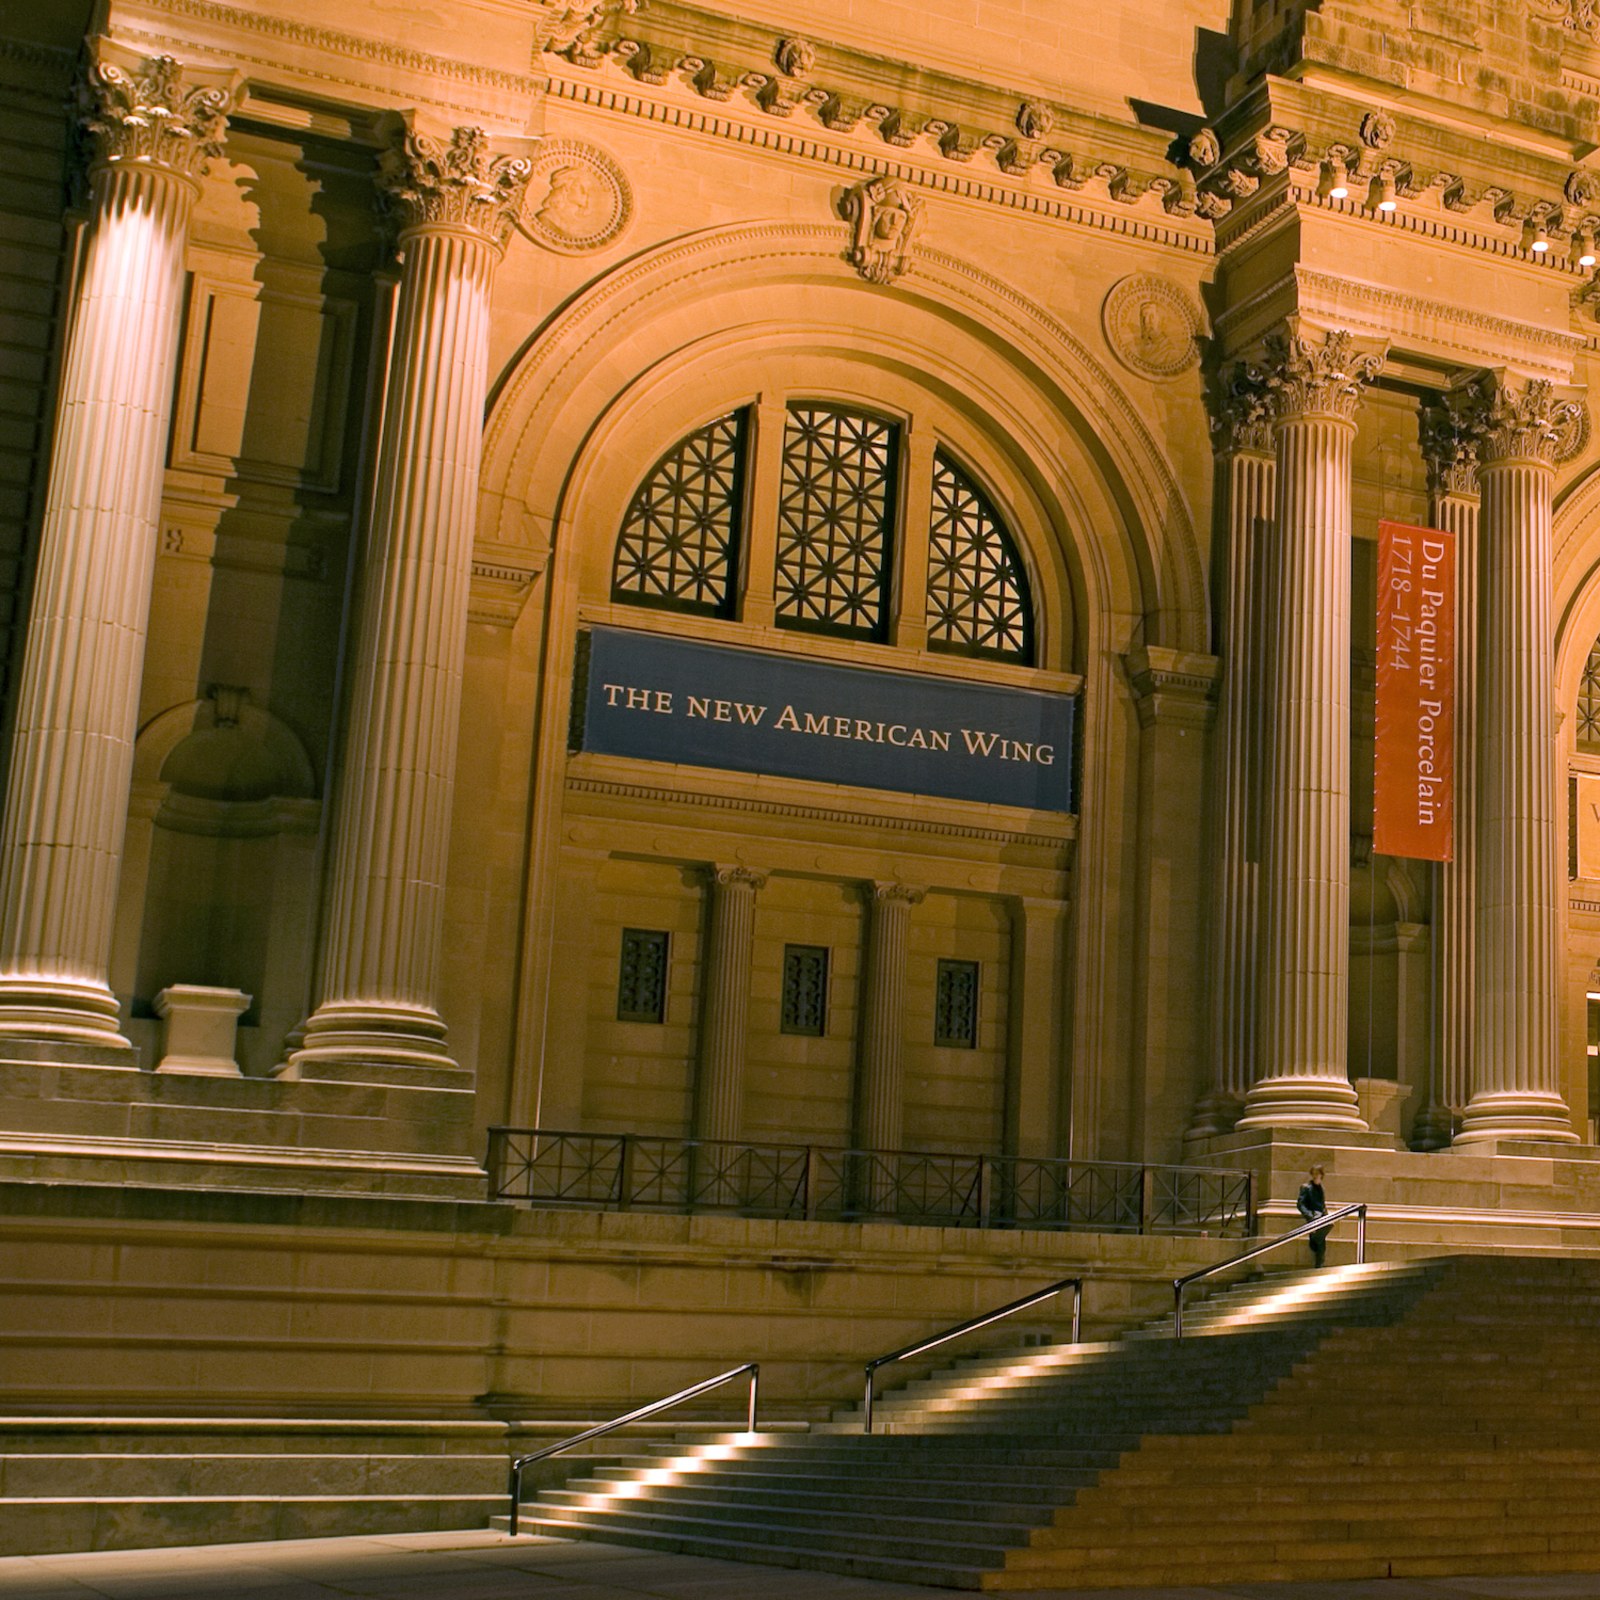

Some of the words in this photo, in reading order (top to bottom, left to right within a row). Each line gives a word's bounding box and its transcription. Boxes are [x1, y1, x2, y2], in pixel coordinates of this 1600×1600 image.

[1421, 538, 1445, 580] Du
[1414, 589, 1445, 691] Paquier
[603, 683, 674, 715] THE
[687, 695, 768, 726] NEW
[774, 704, 951, 752] AMERICAN
[960, 729, 1056, 766] WING
[1418, 699, 1444, 826] Porcelain
